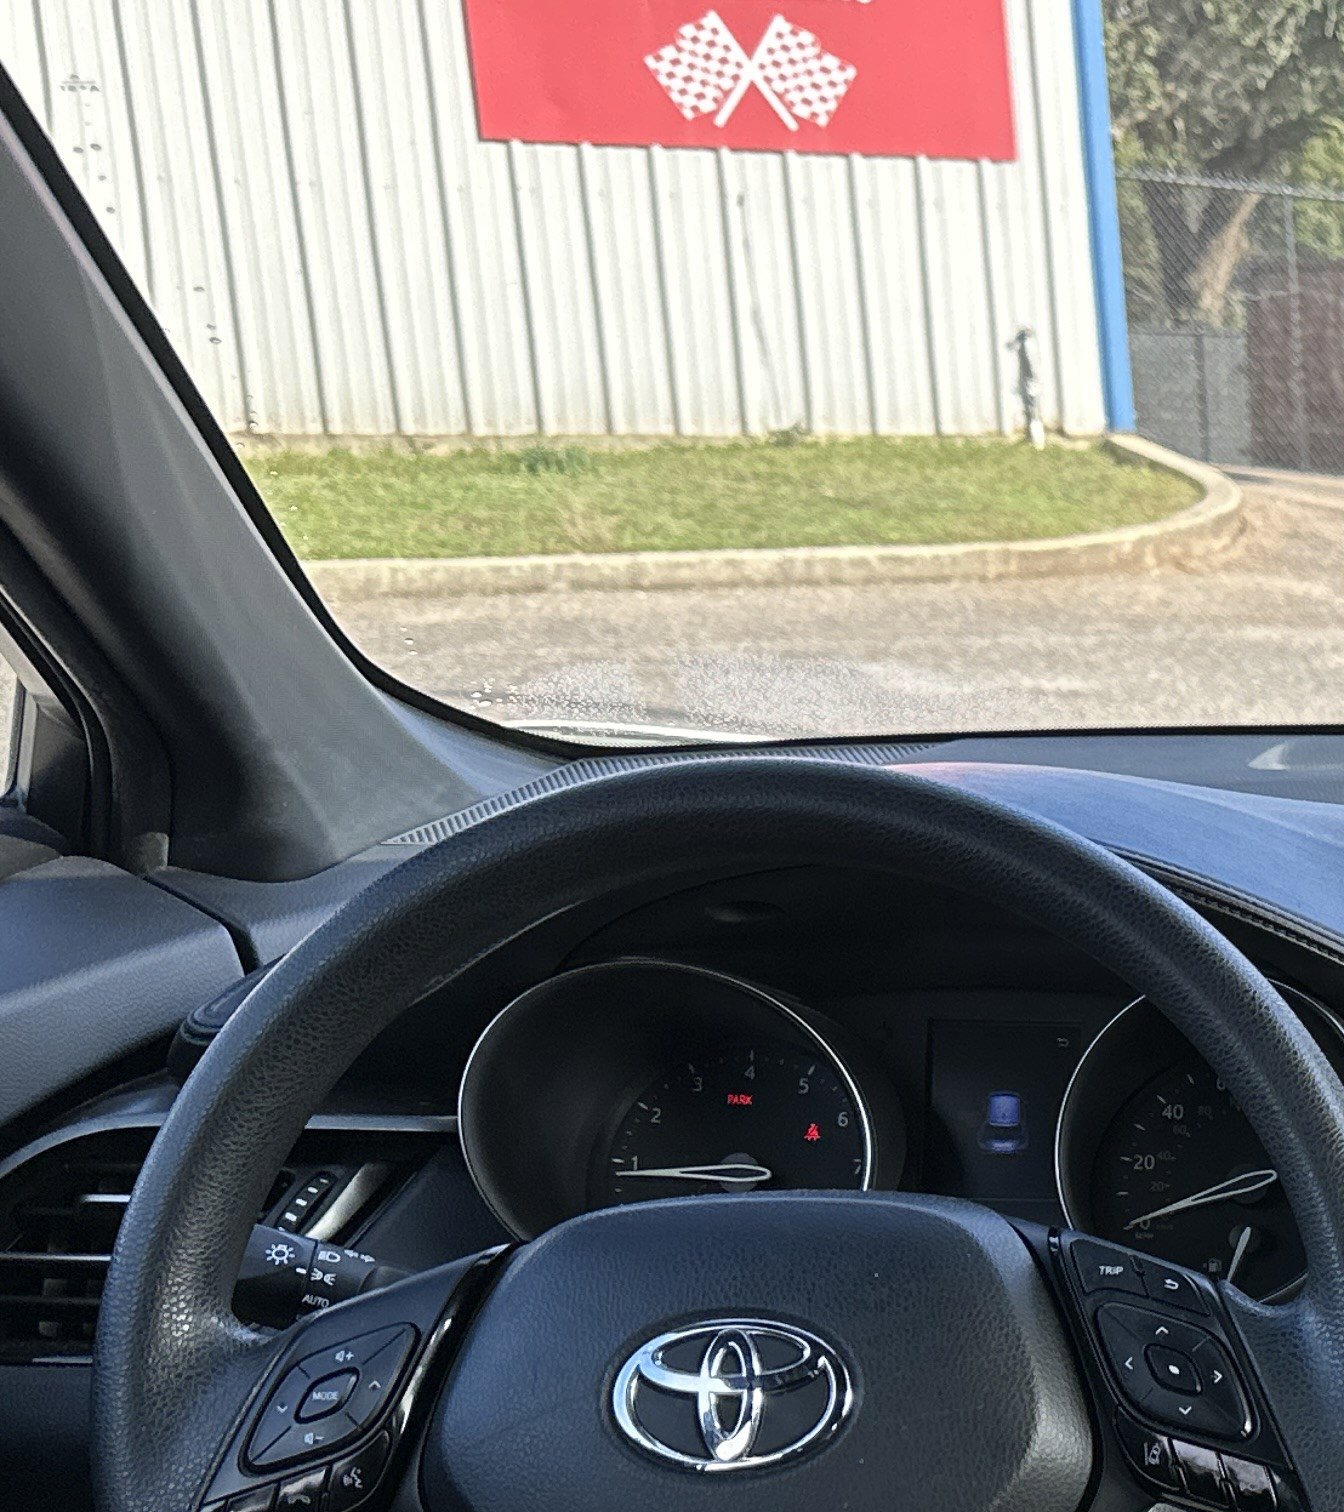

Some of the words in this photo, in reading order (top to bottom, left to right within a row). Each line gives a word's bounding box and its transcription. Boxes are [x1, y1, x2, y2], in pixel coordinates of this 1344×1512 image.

[745, 1065, 755, 1080] 4
[693, 1077, 703, 1092] 3
[799, 1078, 809, 1094] 5
[727, 1094, 753, 1106] PARK
[650, 1108, 661, 1124] 2
[838, 1112, 848, 1127] 6
[1162, 1104, 1184, 1121] 40
[632, 1156, 639, 1170] 1
[1133, 1154, 1155, 1170] 20
[1099, 1264, 1124, 1277] TRIP
[302, 1294, 329, 1308] AUTO
[313, 1391, 339, 1400] MODE
